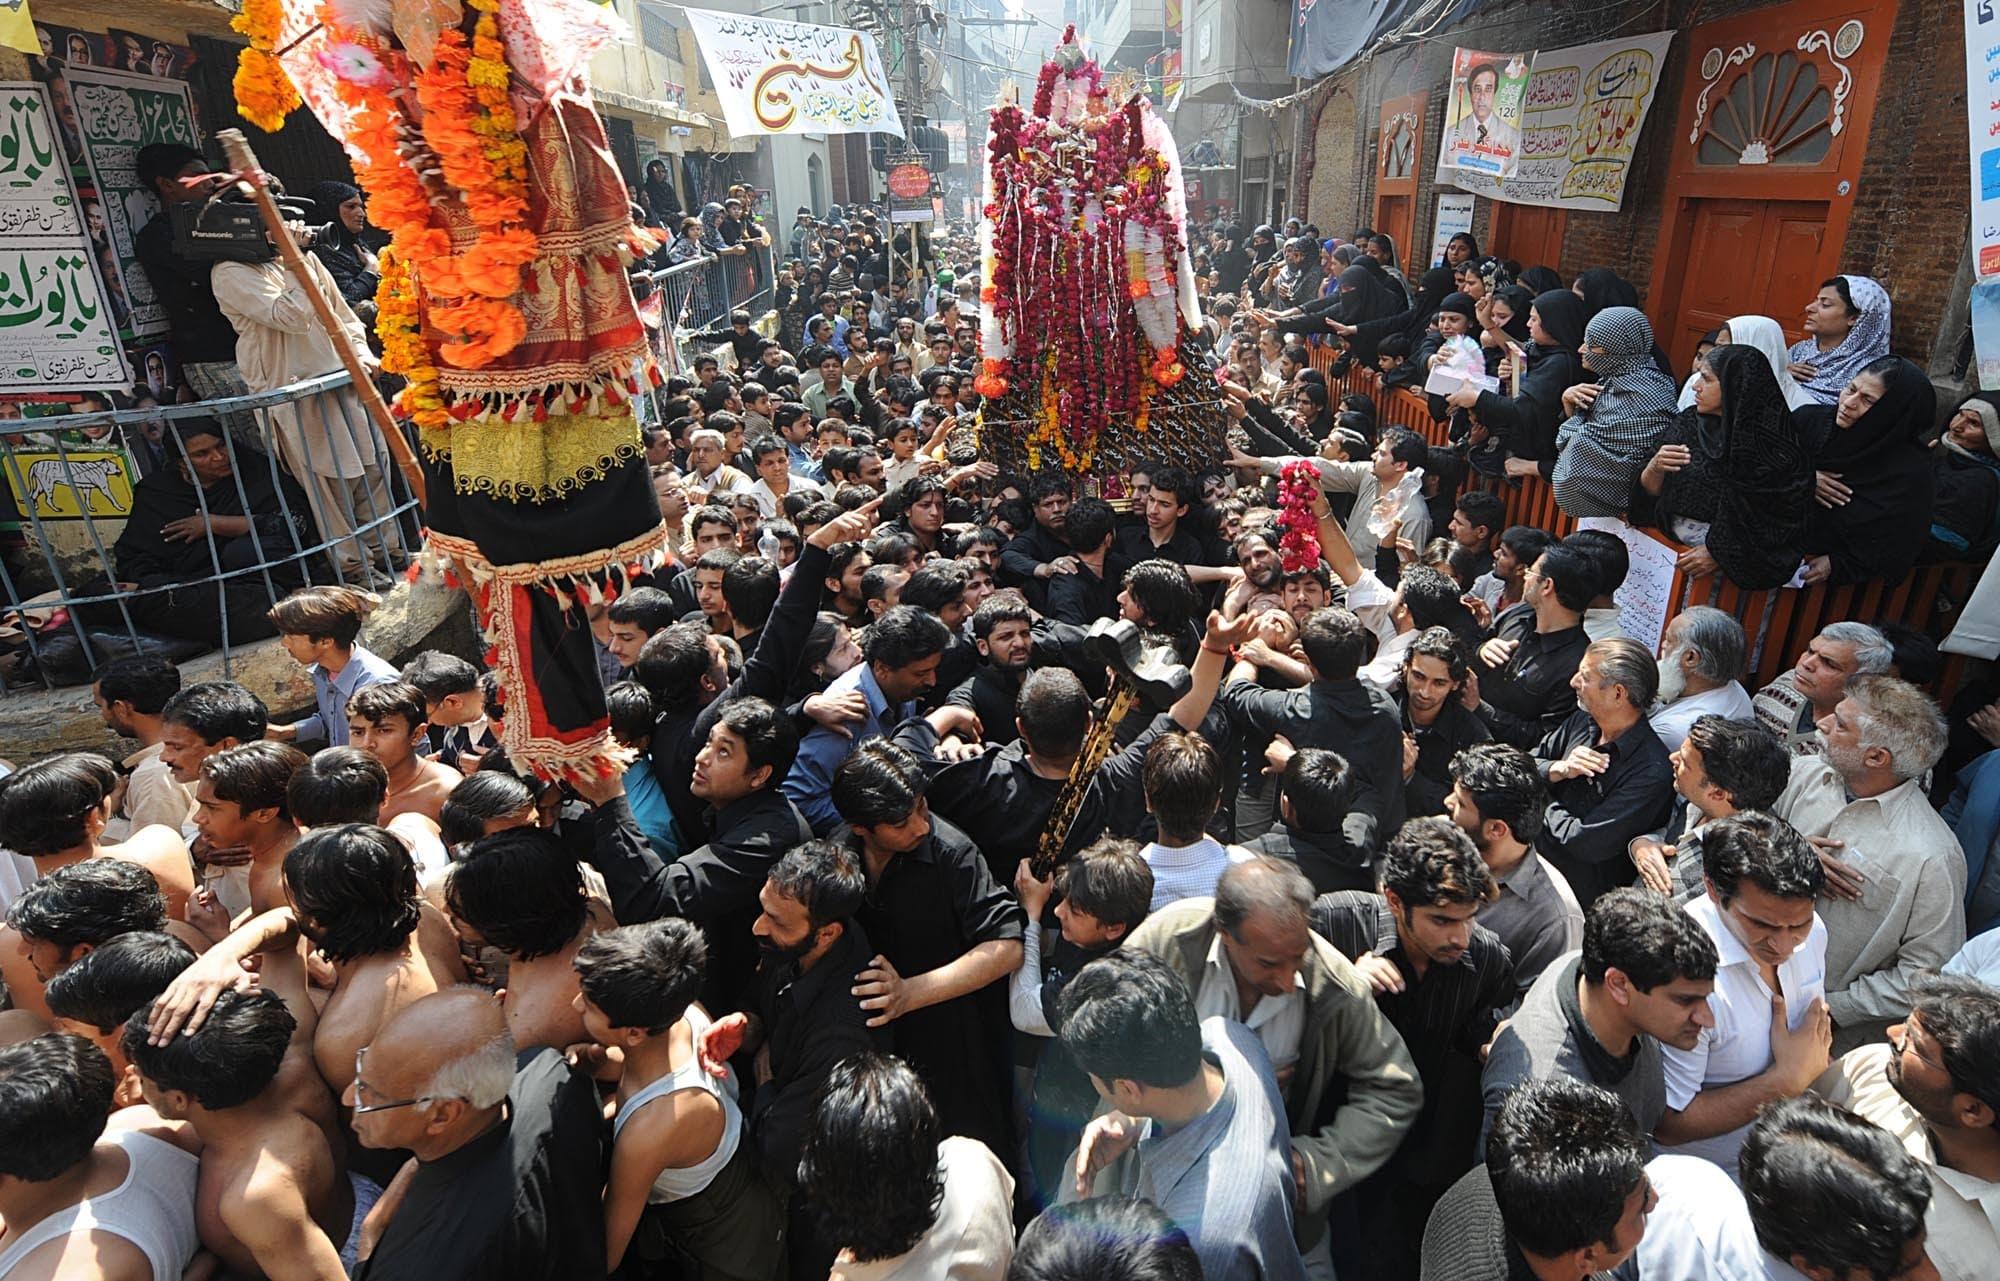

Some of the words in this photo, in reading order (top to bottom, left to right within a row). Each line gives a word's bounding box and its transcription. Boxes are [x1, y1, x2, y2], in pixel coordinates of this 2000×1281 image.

[191, 230, 234, 238] Panasonic
[64, 355, 86, 381] ظفر
[83, 357, 112, 378] حسن
